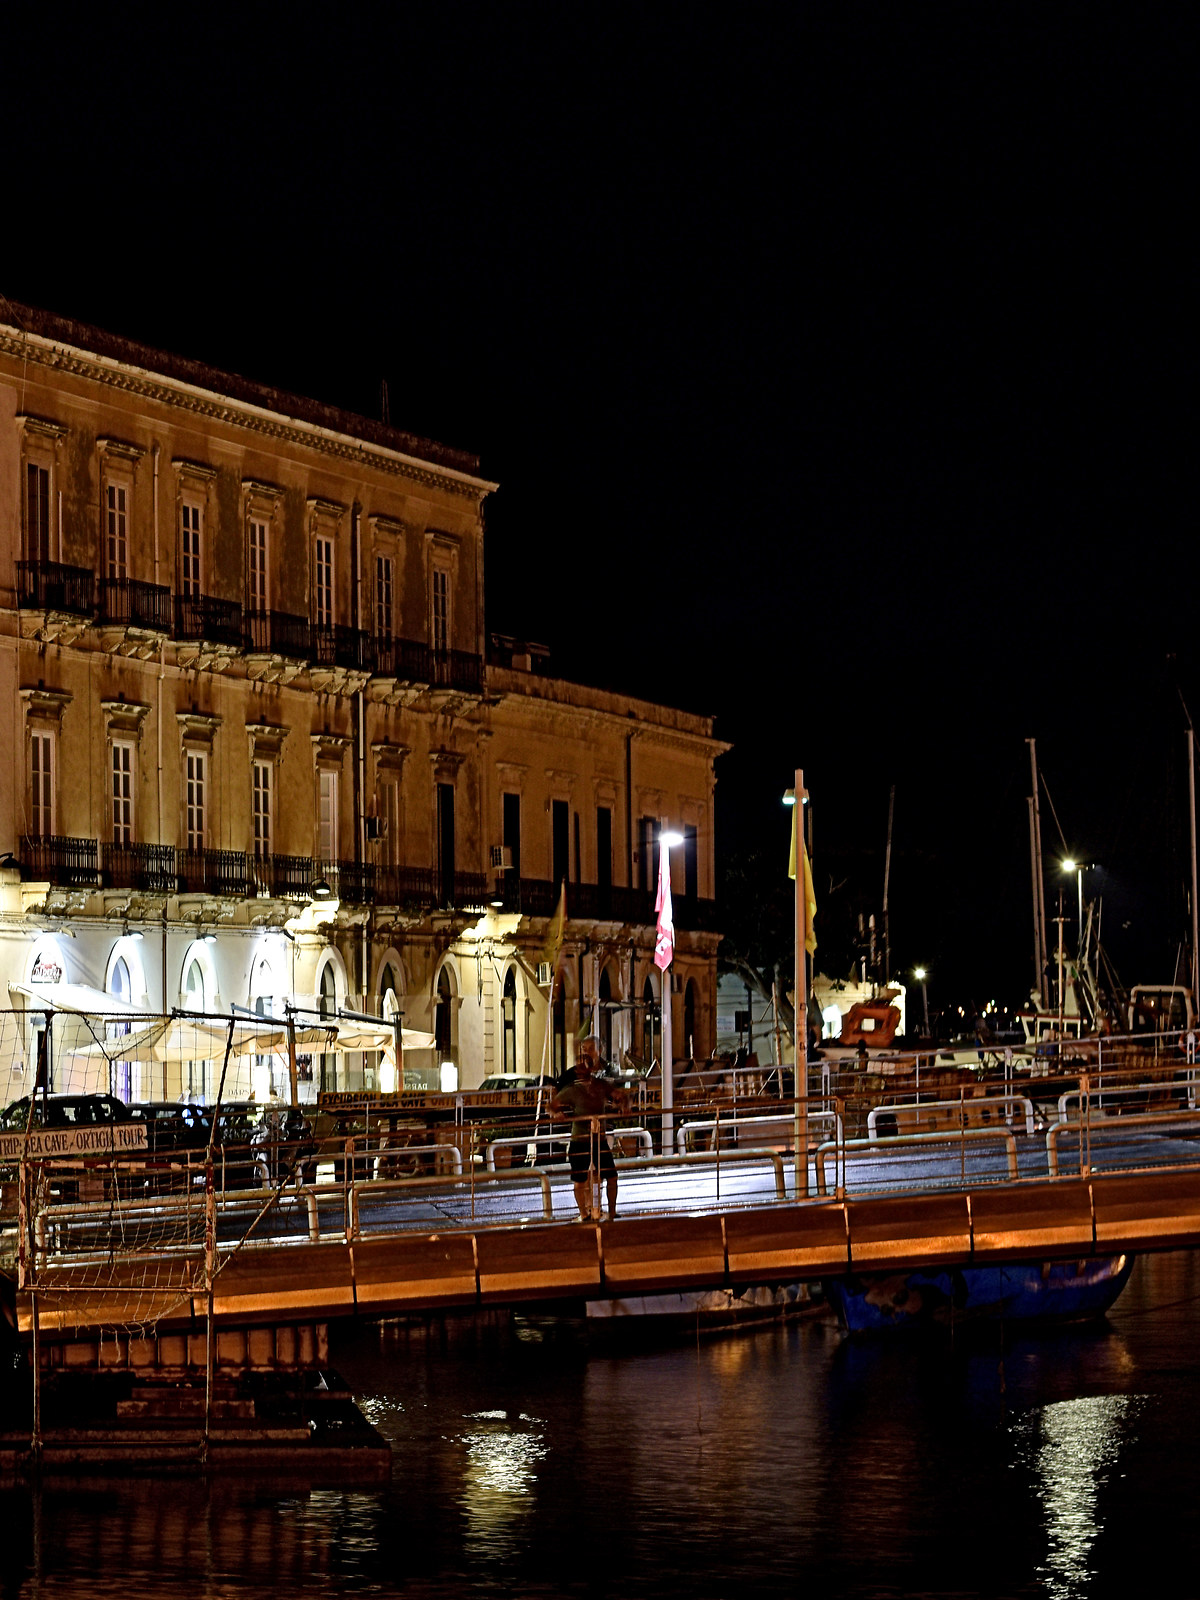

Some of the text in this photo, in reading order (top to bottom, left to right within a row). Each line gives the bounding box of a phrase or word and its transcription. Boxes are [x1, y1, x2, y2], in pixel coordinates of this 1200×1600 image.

[322, 1093, 376, 1108] EXCURSION
[380, 1093, 399, 1107] SEA
[401, 1091, 426, 1107] CAVE
[476, 1091, 503, 1105] TOUR
[24, 1136, 43, 1153] SEA
[44, 1133, 69, 1152] CAVE
[117, 1127, 145, 1147] TOUR
